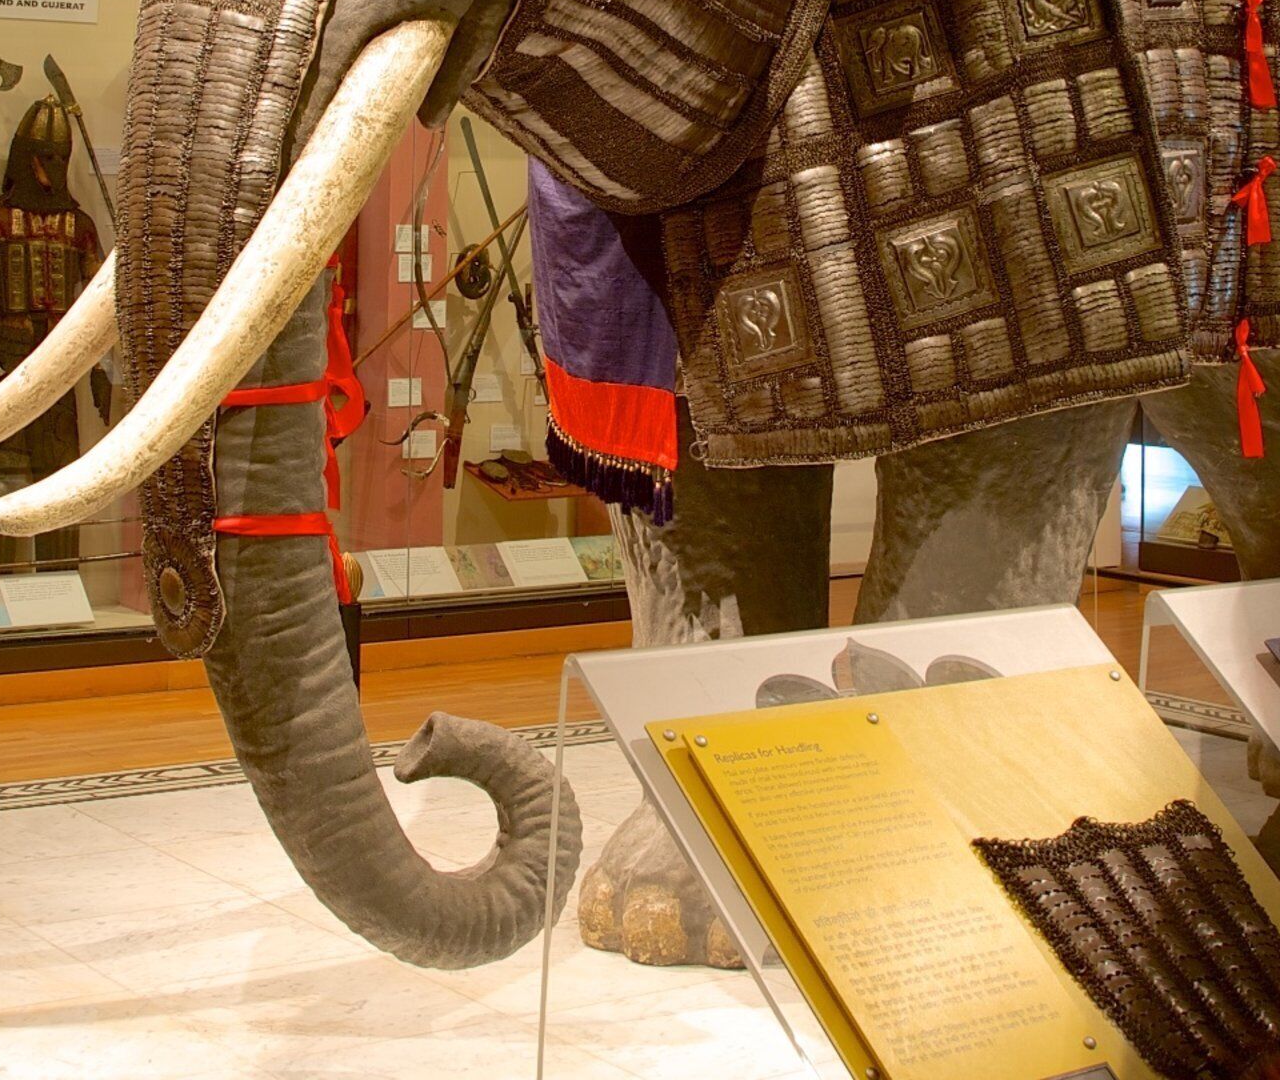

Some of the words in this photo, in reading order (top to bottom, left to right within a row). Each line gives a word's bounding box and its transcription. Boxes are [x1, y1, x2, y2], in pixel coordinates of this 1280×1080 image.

[16, 0, 38, 8] AND
[41, 1, 85, 10] GUJERAT
[714, 751, 757, 764] Replicas
[757, 748, 773, 757] for
[775, 743, 822, 754] Handling
